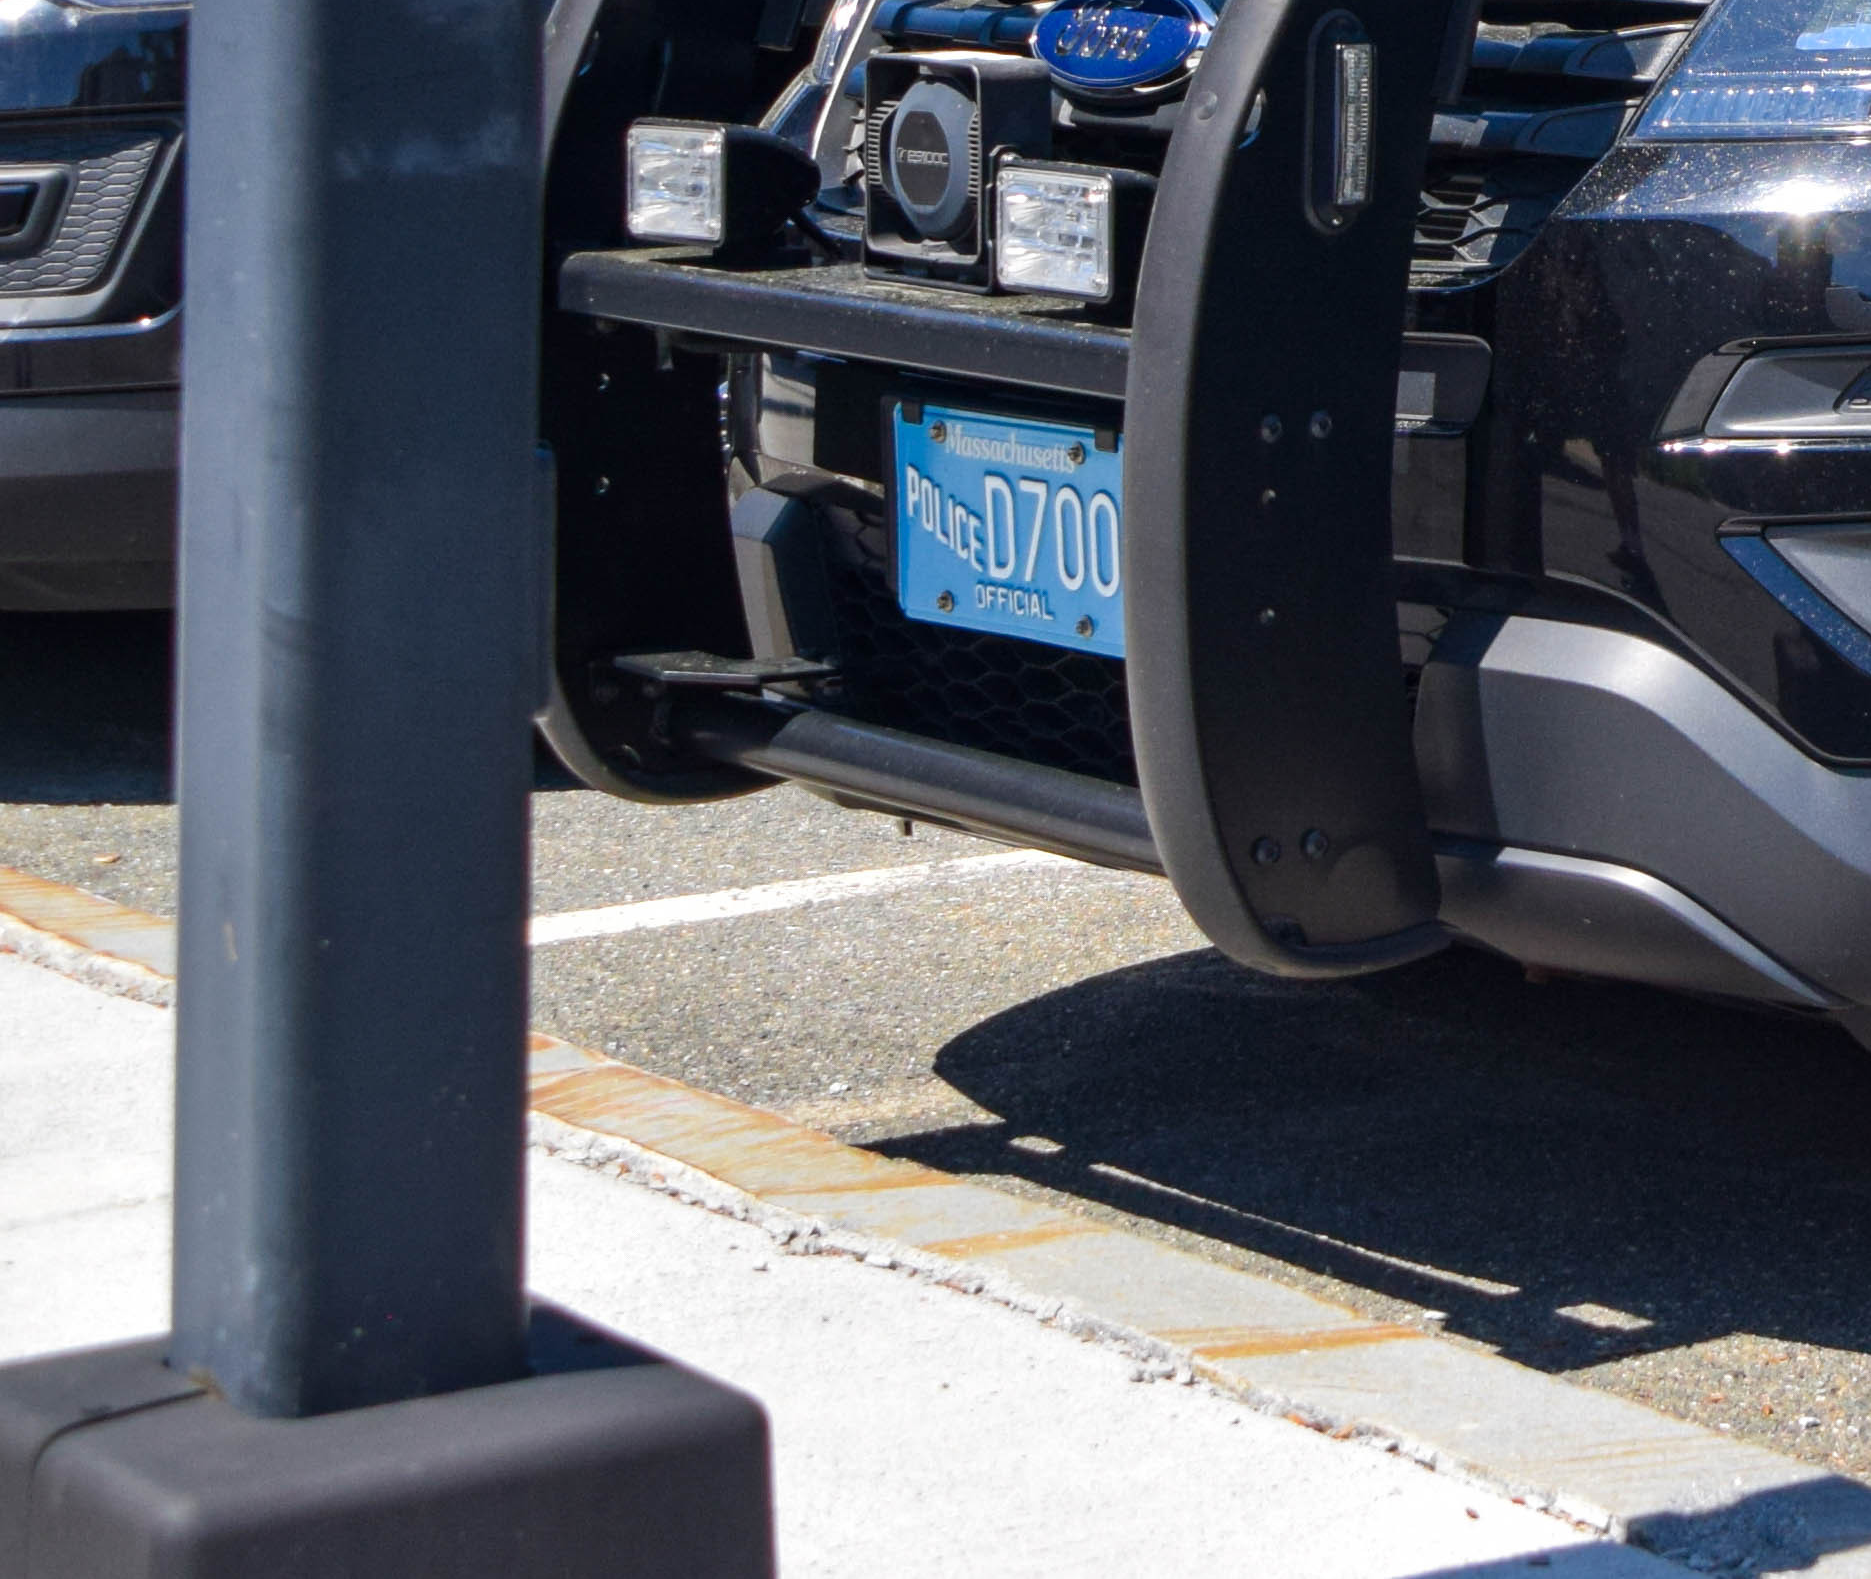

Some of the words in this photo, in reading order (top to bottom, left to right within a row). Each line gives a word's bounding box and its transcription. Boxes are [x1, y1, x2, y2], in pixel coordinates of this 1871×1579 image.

[946, 424, 1076, 474] Massachusetts
[906, 465, 984, 573] POLICE
[984, 473, 1121, 598] D700
[975, 583, 1056, 621] OFFICIAL
